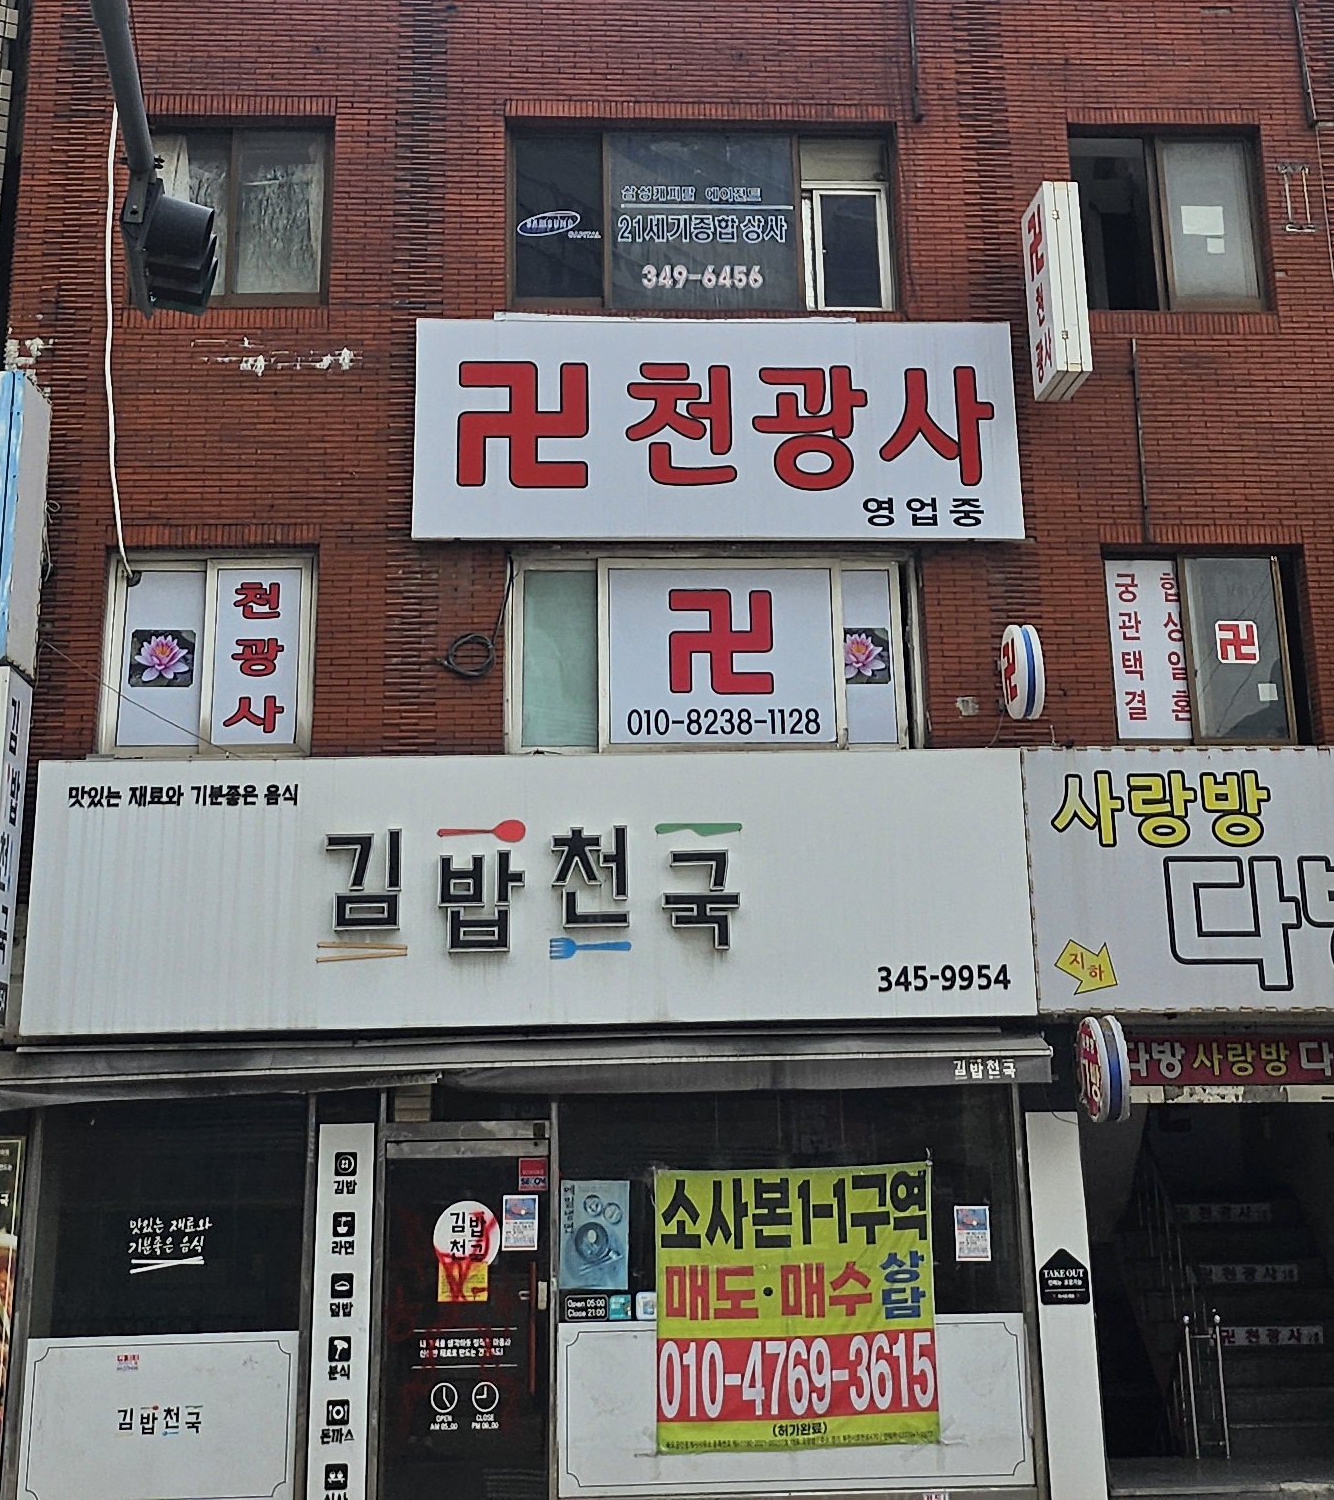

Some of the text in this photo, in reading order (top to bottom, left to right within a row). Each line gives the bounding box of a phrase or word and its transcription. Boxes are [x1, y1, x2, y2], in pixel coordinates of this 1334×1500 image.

[621, 185, 696, 202] 삼성캐피탈
[641, 264, 764, 289] 349-6456
[625, 363, 995, 492] 천광사
[861, 496, 985, 528] 영업중
[223, 581, 285, 734] 천광사
[626, 707, 821, 736] 010-8238-1128
[68, 783, 299, 808] 맛있는 재료와 기분좋은 음식
[1051, 770, 1271, 847] 사랑방
[325, 824, 741, 953] 김밥천국
[1068, 951, 1105, 982] 지하
[877, 963, 1011, 993] 345-9954
[953, 1058, 1017, 1079] 김밥천국
[1192, 1040, 1290, 1078] 사랑방
[334, 1180, 357, 1195] 김밥
[660, 1168, 928, 1250] 소사본1-1구역
[129, 1216, 214, 1234] 맛있는 재료와
[450, 1211, 486, 1239] 김밥
[128, 1235, 205, 1255] 기분좋은 음식
[331, 1240, 355, 1255] 라면
[1043, 1268, 1085, 1279] TAKE OUT
[879, 1249, 927, 1321] 상담
[329, 1301, 353, 1317] 덮밥
[567, 1300, 586, 1309] Open
[567, 1308, 606, 1318] Close 21:00
[327, 1363, 351, 1381] 분식
[659, 1330, 935, 1420] 010-4769-3615
[117, 1406, 202, 1435] 김밥천국
[430, 1423, 441, 1431] AM
[435, 1414, 453, 1423] OPEN
[471, 1422, 481, 1430] PM
[476, 1413, 495, 1422] CLOSE
[320, 1428, 355, 1445] 돈까스
[772, 1420, 828, 1438] (허가완료)
